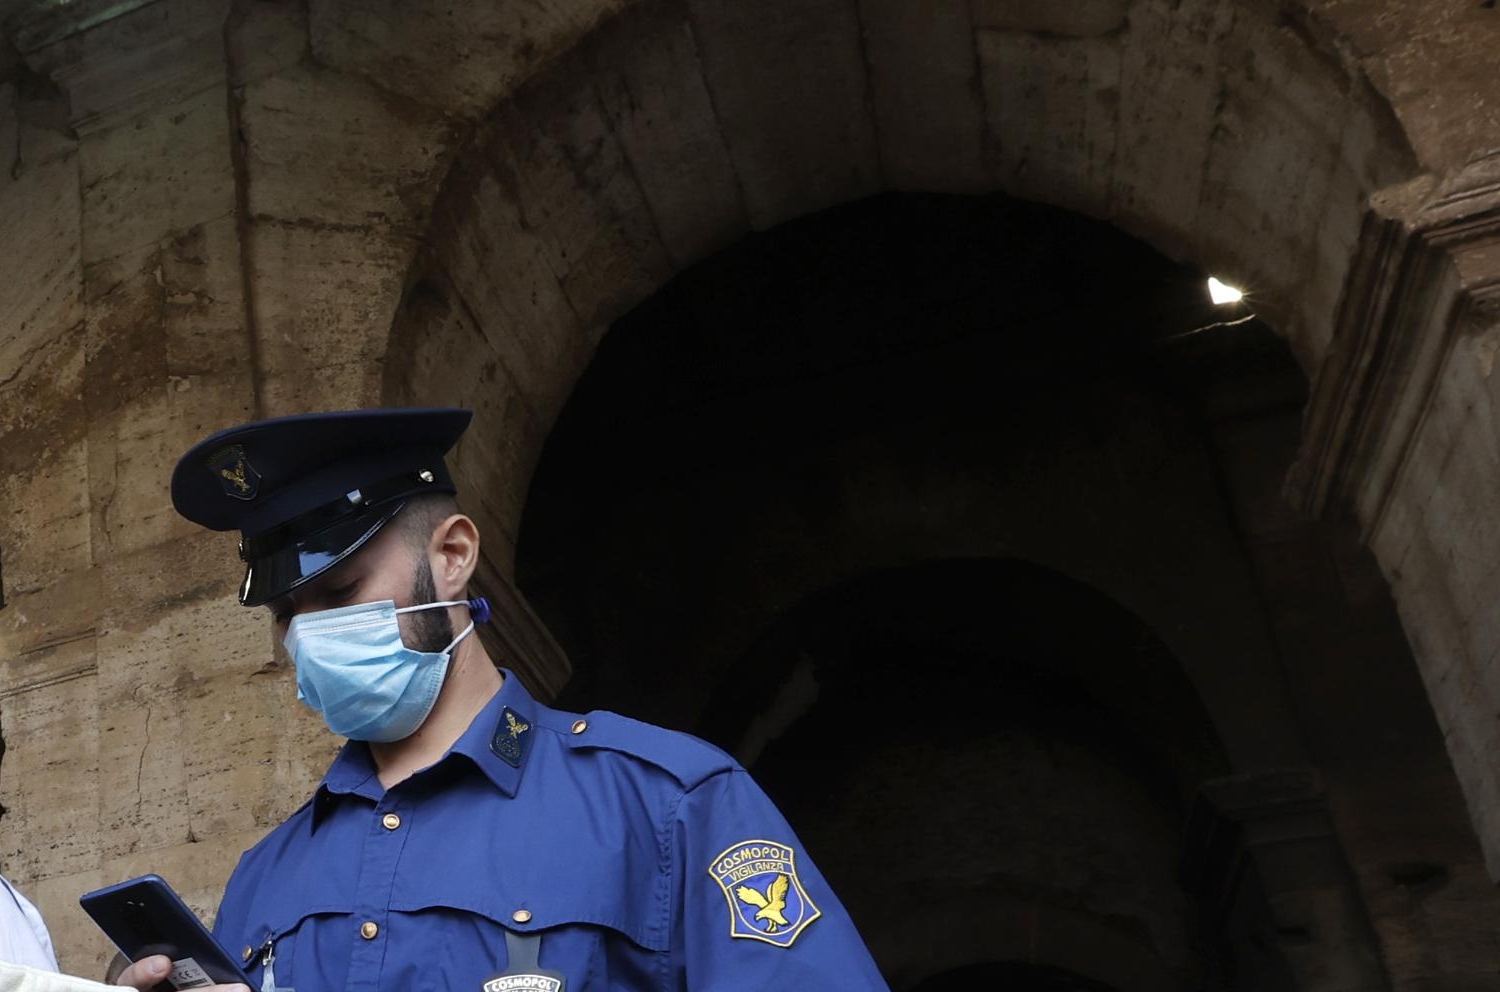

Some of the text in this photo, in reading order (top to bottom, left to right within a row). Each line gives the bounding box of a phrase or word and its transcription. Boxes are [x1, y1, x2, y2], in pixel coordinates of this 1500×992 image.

[717, 846, 789, 874] COSMOPOL
[728, 862, 785, 881] VIGILANZA
[491, 977, 552, 992] COSMOPOL
